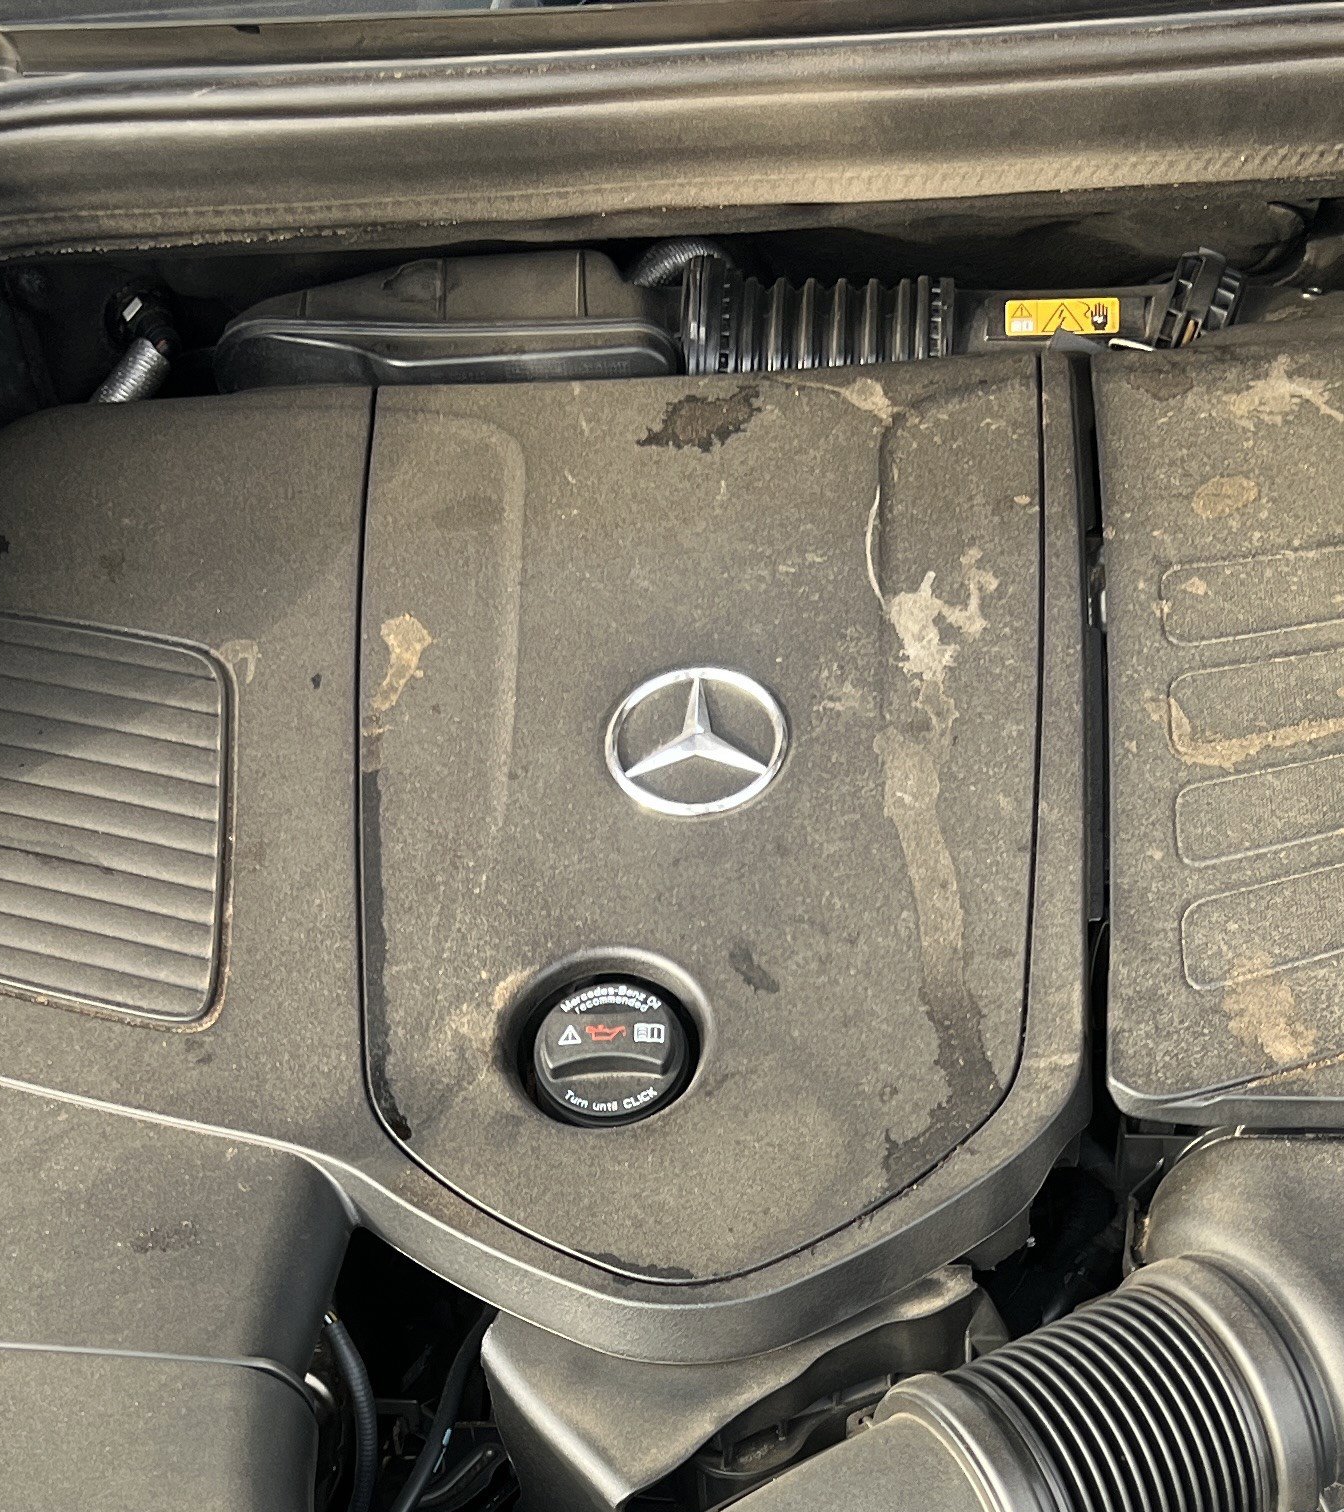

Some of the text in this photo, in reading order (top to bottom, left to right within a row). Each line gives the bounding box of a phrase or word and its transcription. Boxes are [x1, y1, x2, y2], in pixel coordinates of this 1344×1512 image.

[560, 986, 646, 1012] Mercedes-Benz
[575, 996, 648, 1014] recommended
[565, 1087, 657, 1111] Turn until CLICK
